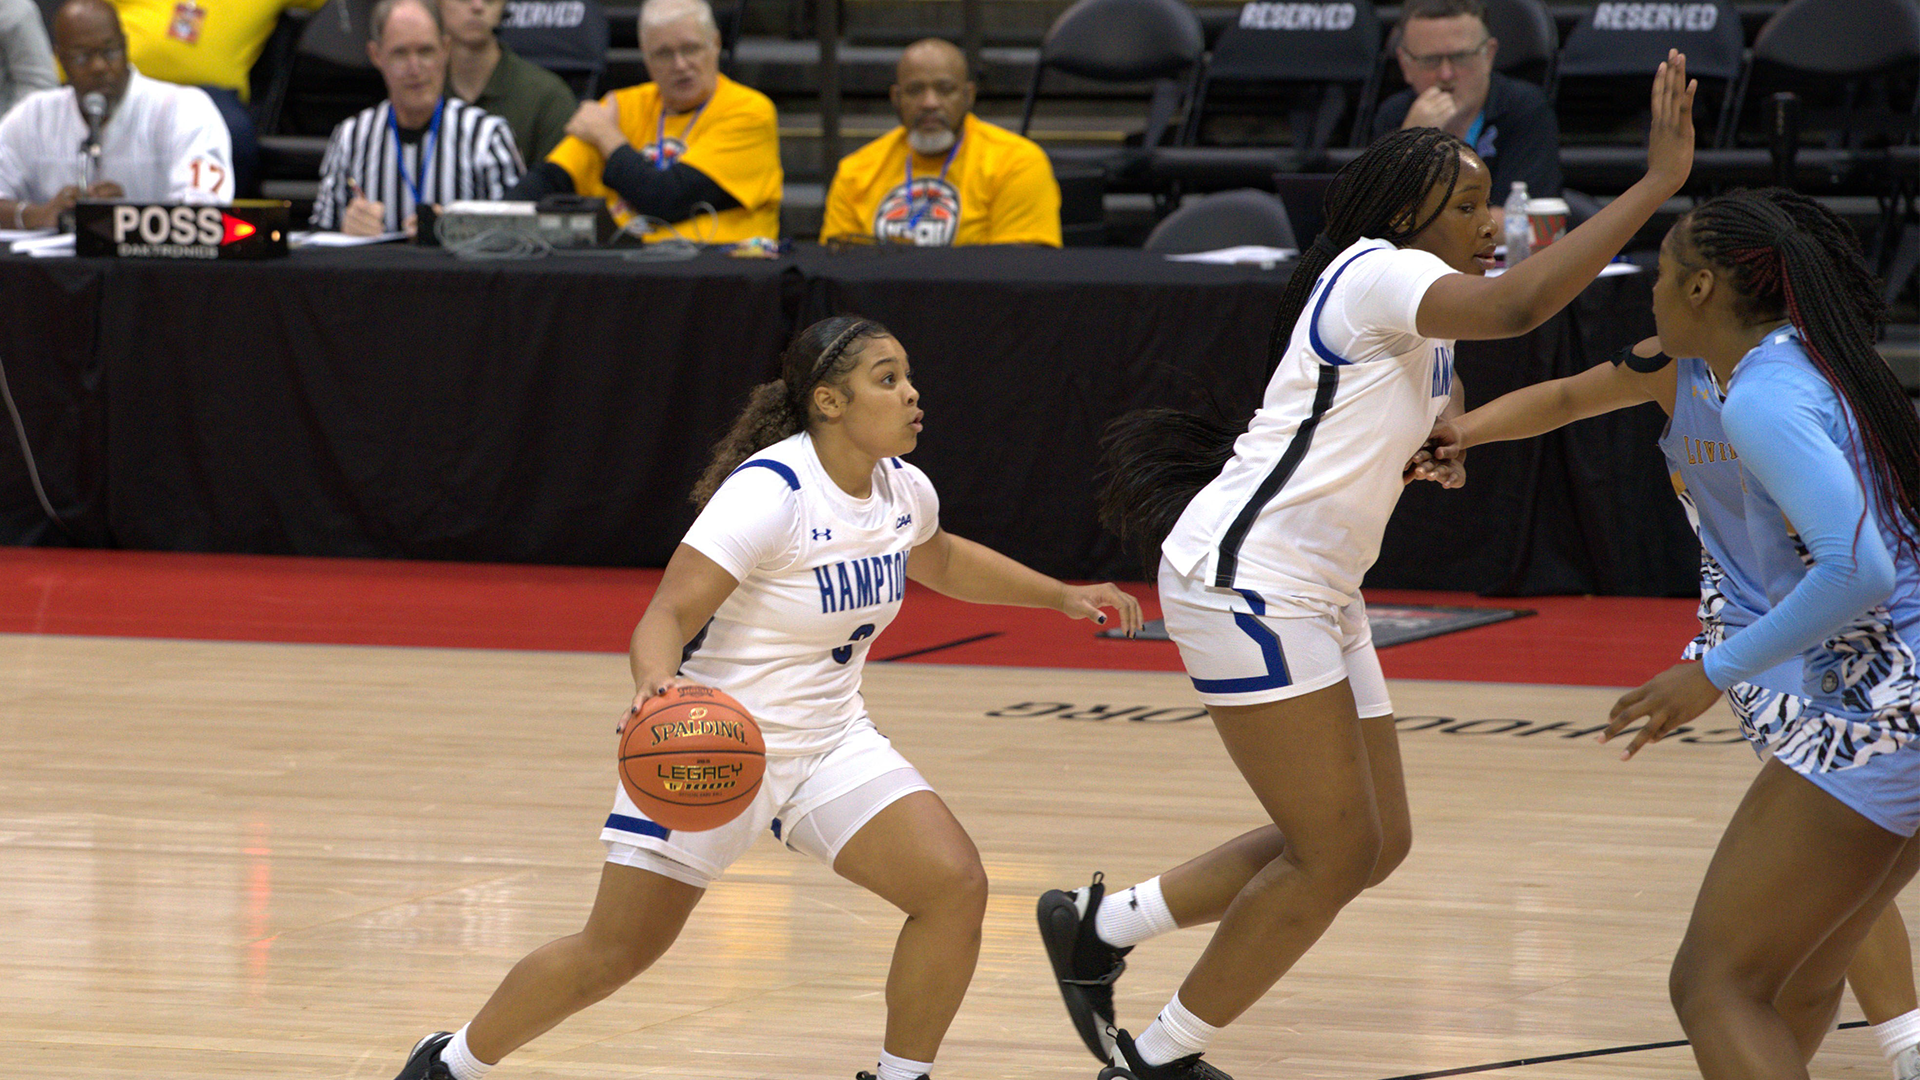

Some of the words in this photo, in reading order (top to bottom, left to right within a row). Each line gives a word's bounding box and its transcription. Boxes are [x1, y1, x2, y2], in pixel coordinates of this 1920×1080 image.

[1239, 2, 1357, 30] RESERVED
[1592, 2, 1719, 31] RESERVED
[190, 158, 226, 193] 17
[114, 206, 224, 245] POSS
[117, 244, 219, 259] DAKTRONICS
[896, 514, 912, 529] CAA
[651, 720, 747, 746] SPALDING
[658, 762, 742, 780] LEGACY
